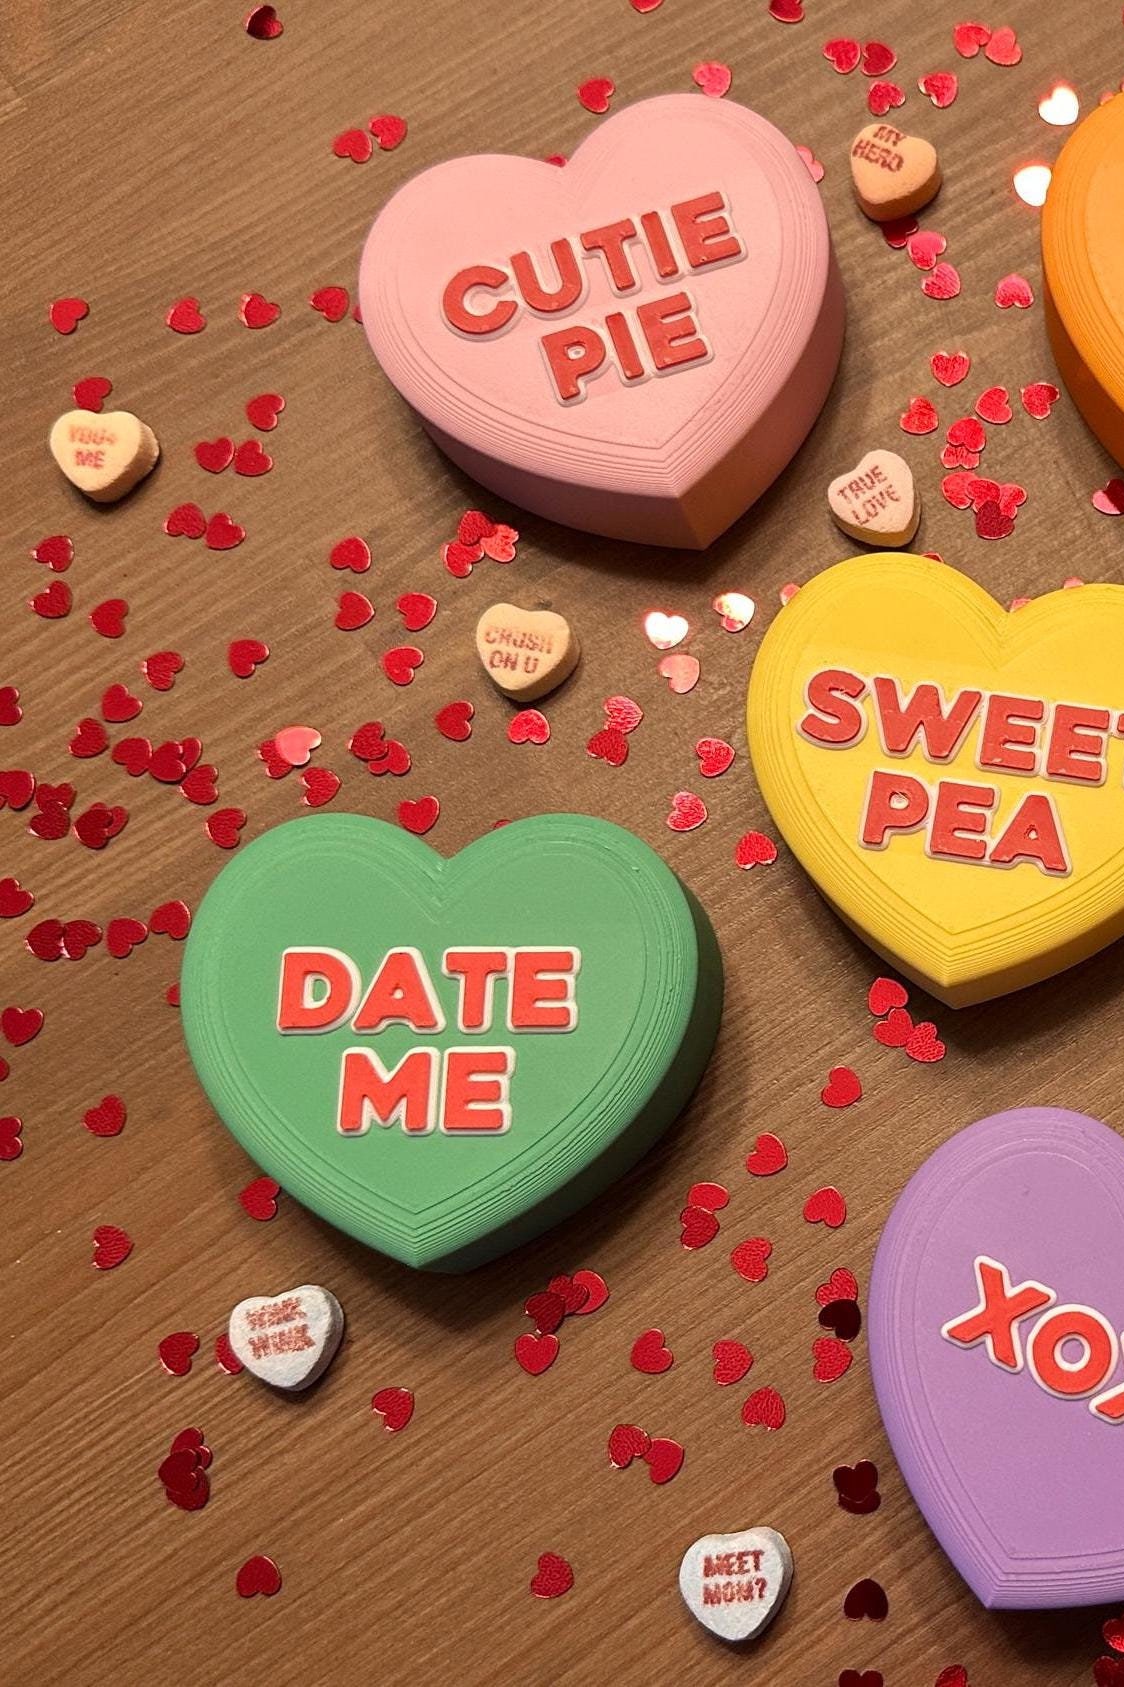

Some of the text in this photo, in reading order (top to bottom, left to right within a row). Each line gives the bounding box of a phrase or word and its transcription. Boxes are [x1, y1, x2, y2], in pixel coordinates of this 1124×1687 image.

[852, 139, 904, 172] HERO
[873, 126, 907, 146] MY
[442, 190, 745, 335] CUTIE
[539, 291, 710, 402] PIE
[837, 465, 888, 503] TRUE
[852, 484, 901, 526] LOVE
[489, 650, 540, 673] ON U
[861, 769, 1070, 875] PEA
[277, 949, 577, 1031] DATE
[338, 1049, 513, 1133] ME
[702, 1549, 765, 1578] MEET
[702, 1577, 768, 1607] MOM?
